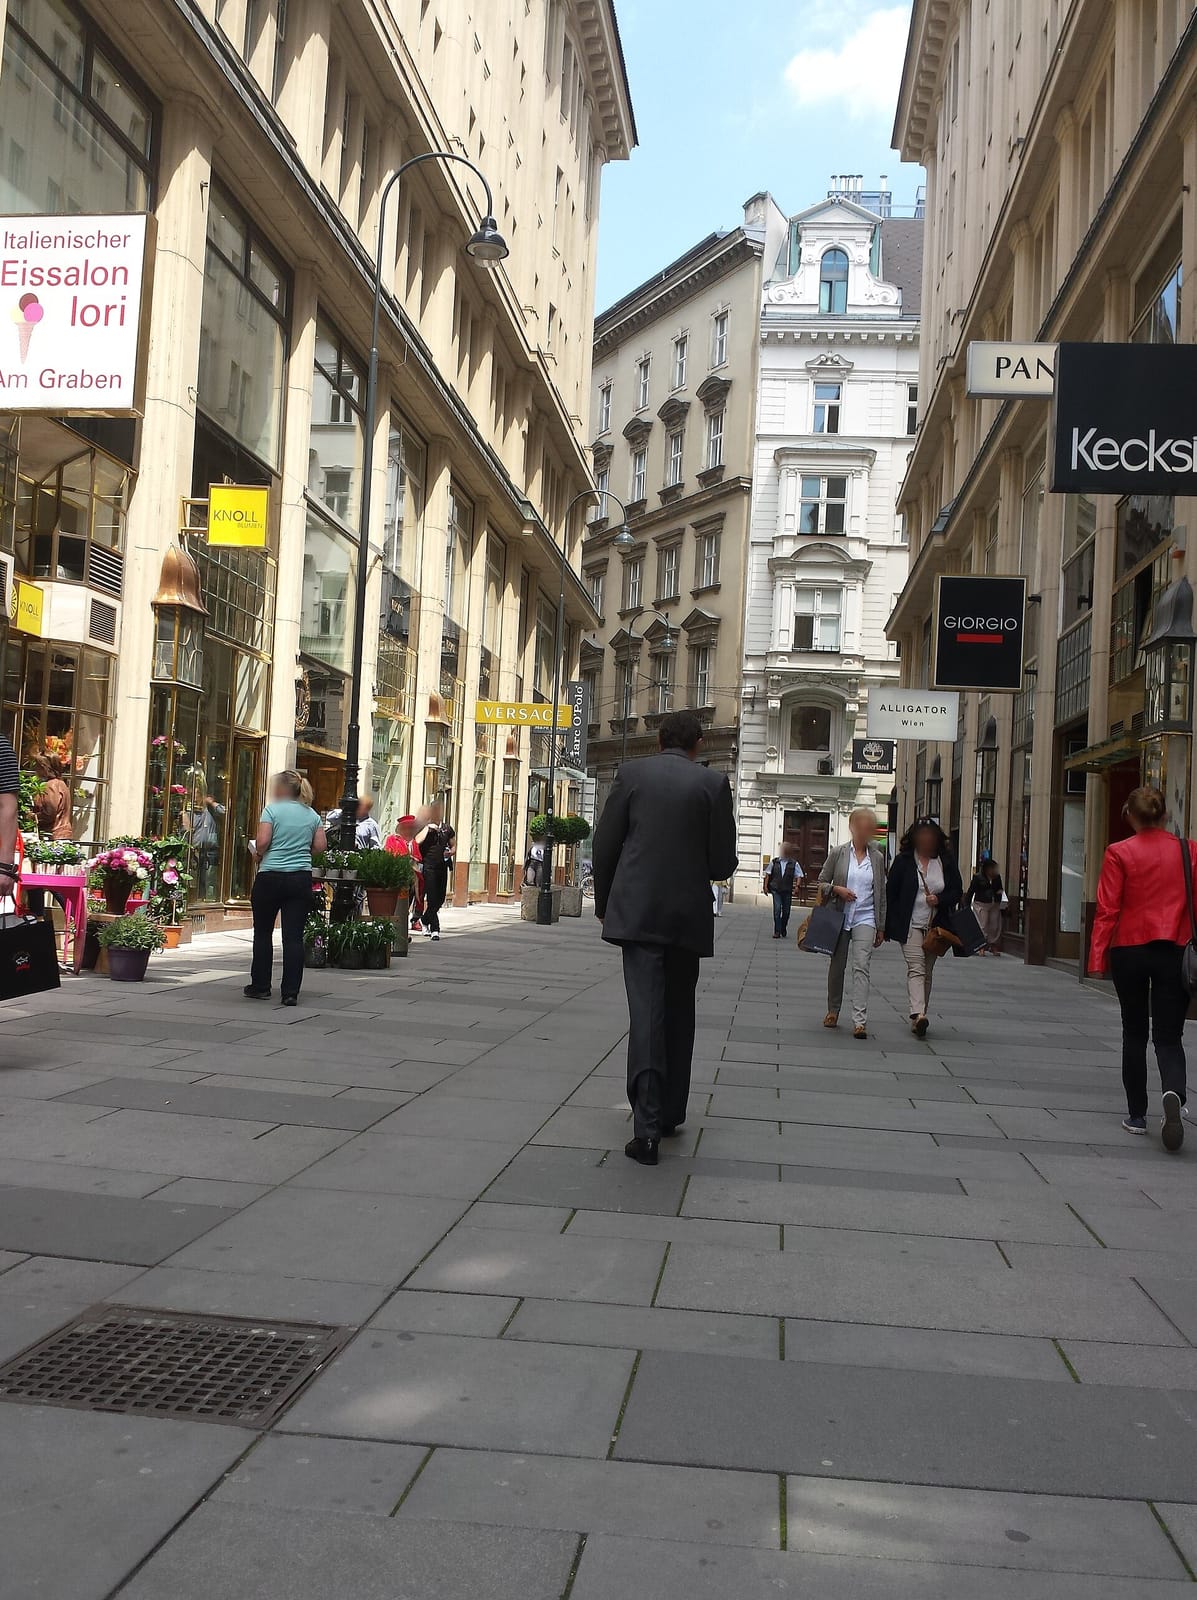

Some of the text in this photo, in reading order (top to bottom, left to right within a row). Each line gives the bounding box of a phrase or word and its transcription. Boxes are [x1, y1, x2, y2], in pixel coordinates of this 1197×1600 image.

[4, 230, 131, 249] Italienischer
[1, 259, 129, 286] Eissalon
[39, 368, 122, 389] Graben
[213, 510, 258, 523] KNOLL
[943, 616, 1018, 631] GIORGIO
[483, 706, 564, 722] VERSACE
[879, 704, 947, 715] ALLIGATOR
[901, 719, 924, 727] Wien
[856, 761, 889, 771] Timberland
